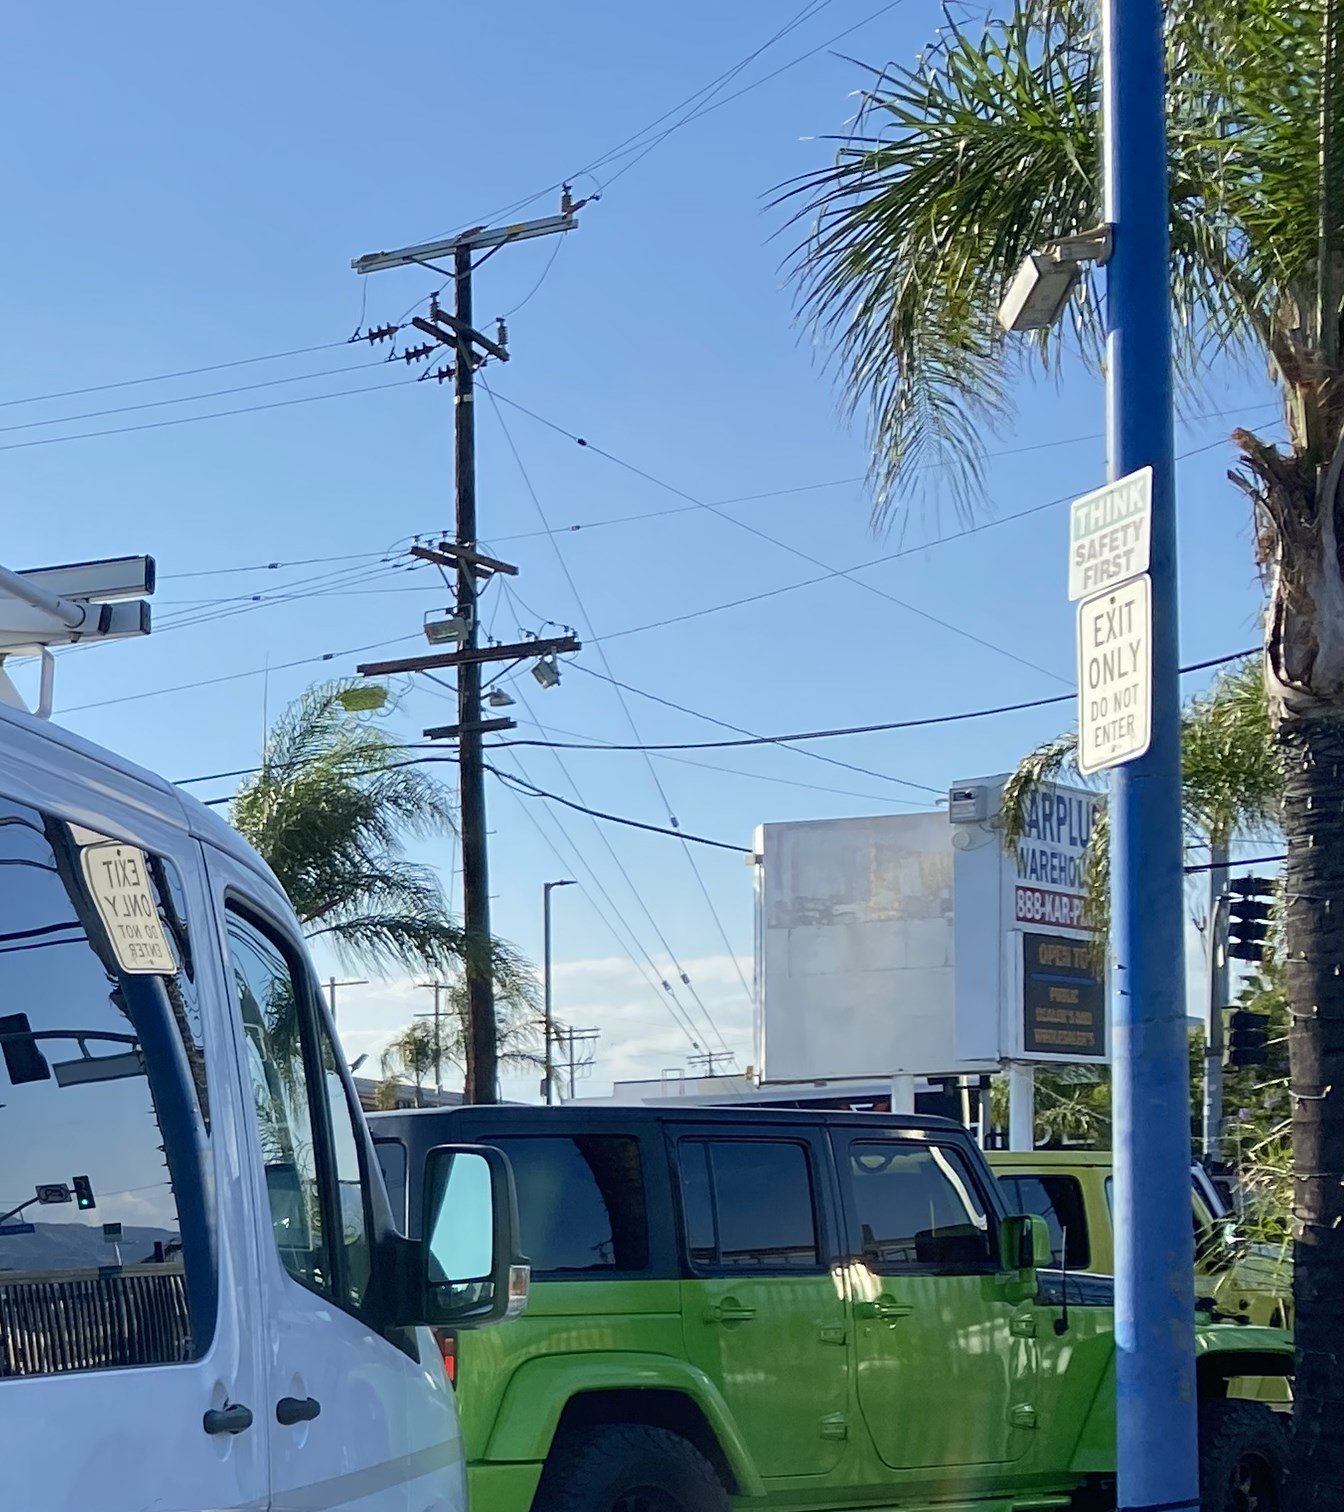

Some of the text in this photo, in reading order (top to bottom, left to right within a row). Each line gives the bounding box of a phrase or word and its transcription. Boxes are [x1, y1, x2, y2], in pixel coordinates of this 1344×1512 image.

[1076, 478, 1145, 537] THINK
[1075, 516, 1144, 567] SAFETY
[1082, 548, 1135, 590] FIRST
[1094, 600, 1135, 647] EXIT
[1089, 638, 1141, 689] ONLY
[1091, 683, 1139, 722] DO NOT
[1094, 714, 1135, 747] ENTER
